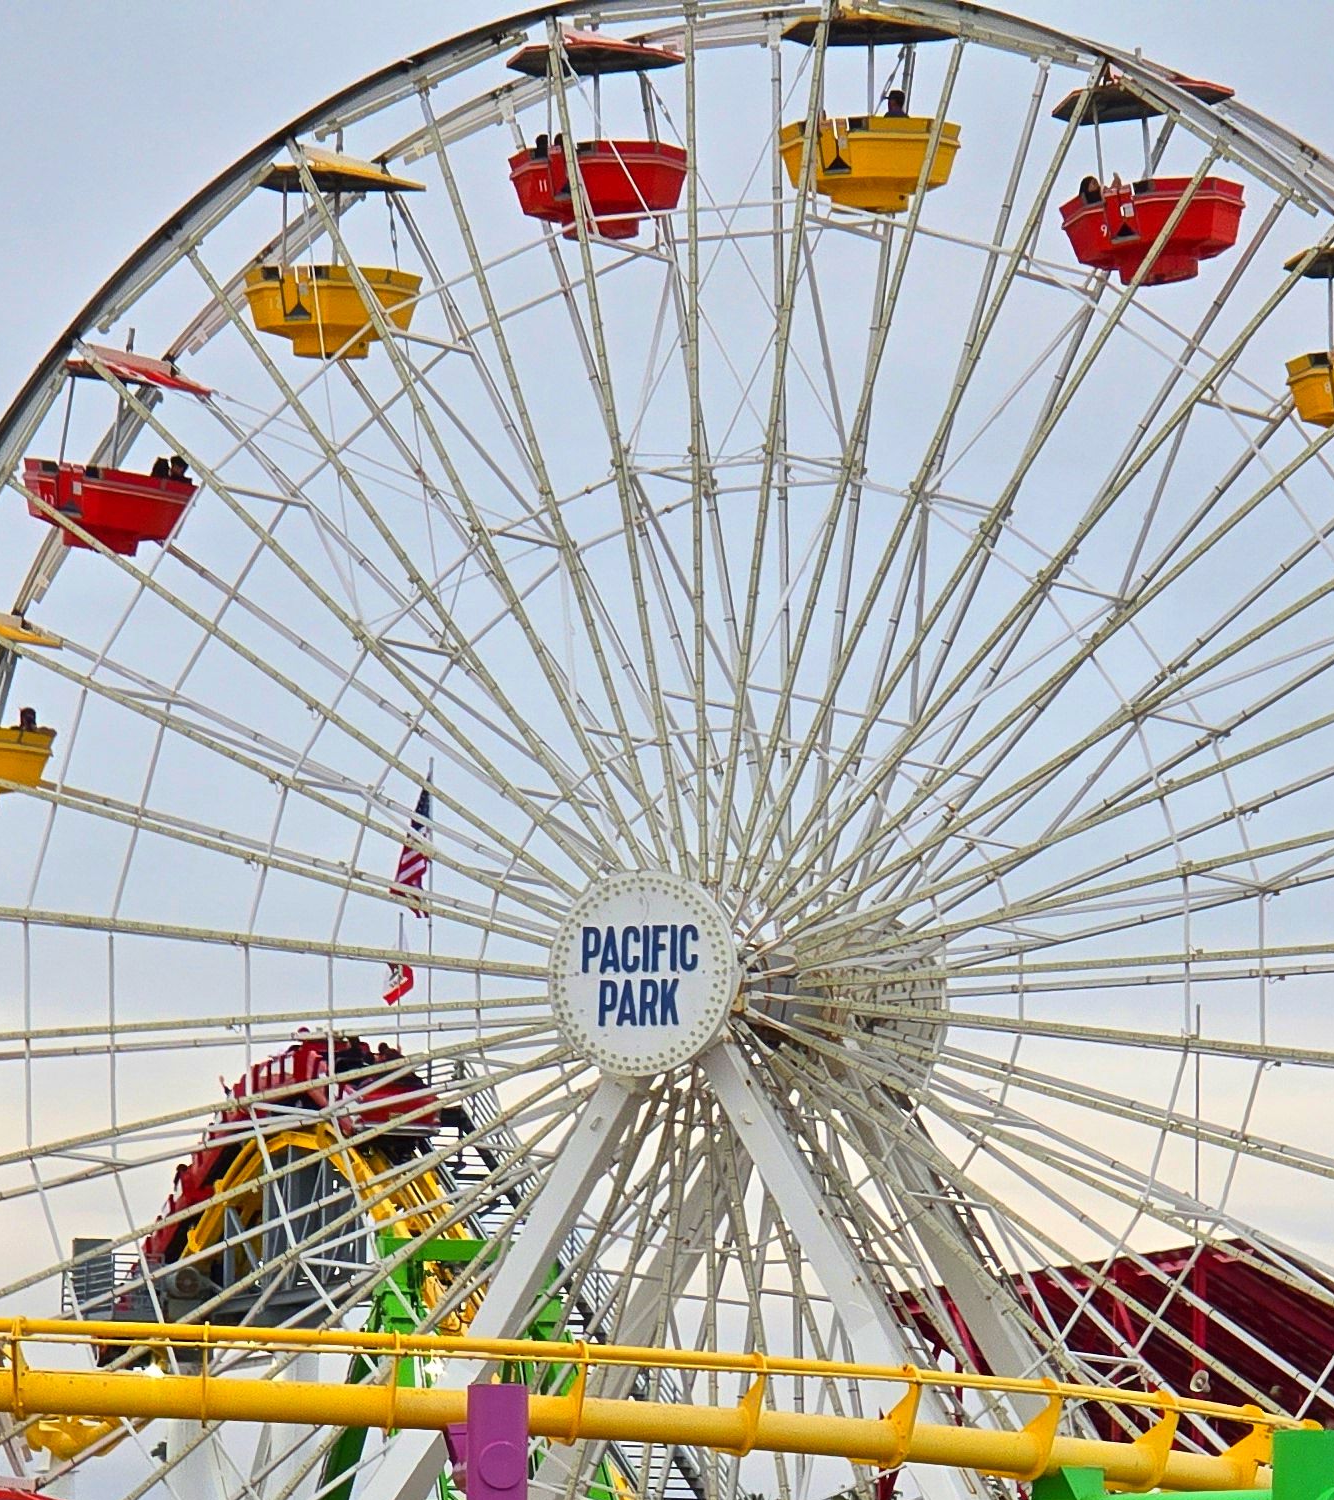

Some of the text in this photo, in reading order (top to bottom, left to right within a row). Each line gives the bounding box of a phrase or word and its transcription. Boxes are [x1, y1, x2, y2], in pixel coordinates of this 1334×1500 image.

[538, 179, 548, 193] 11
[581, 924, 700, 974] PACIFIC
[597, 978, 680, 1027] PARK
